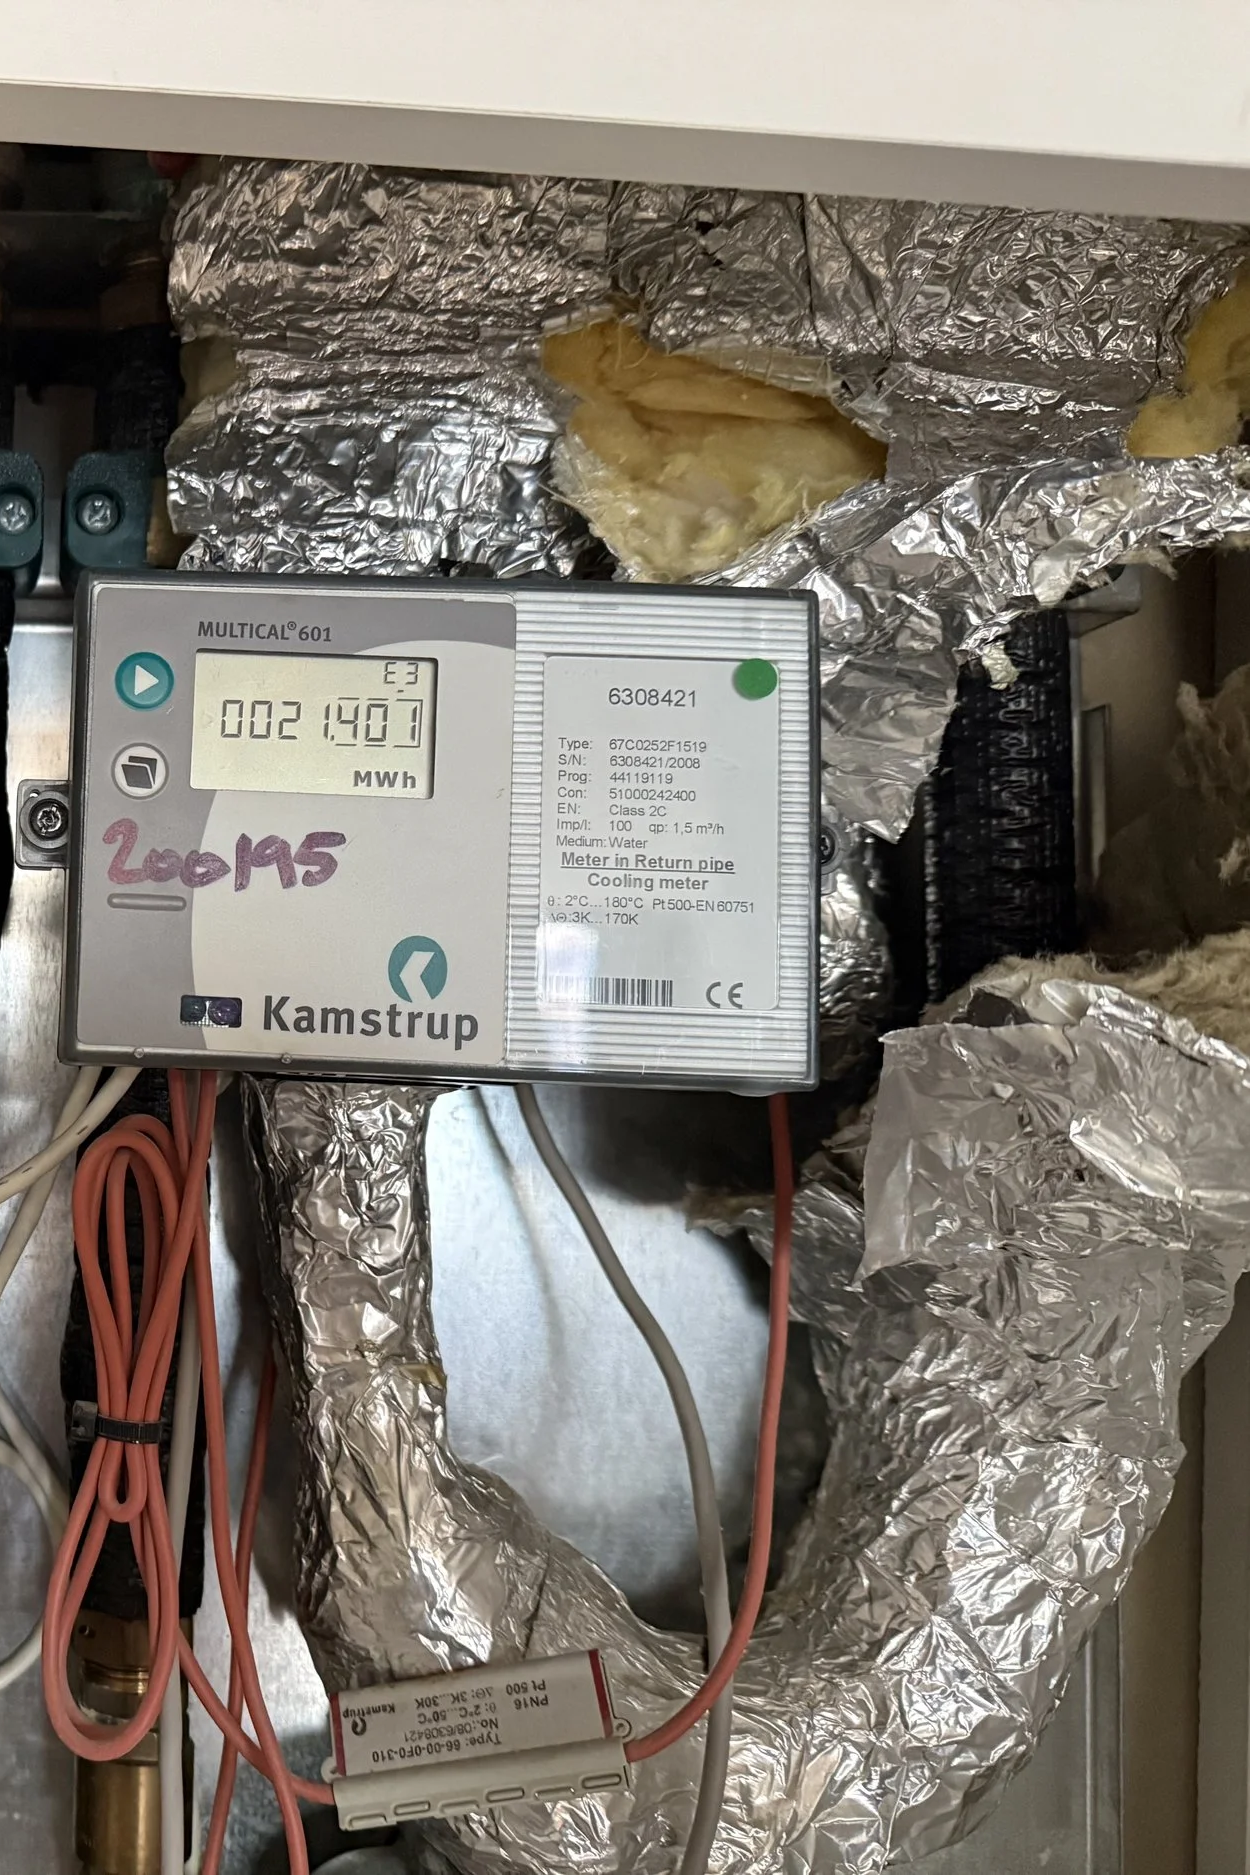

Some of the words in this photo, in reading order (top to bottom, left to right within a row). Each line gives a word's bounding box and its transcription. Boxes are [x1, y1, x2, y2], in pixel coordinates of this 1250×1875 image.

[298, 626, 332, 643] 601
[608, 688, 697, 708] 6308421
[558, 737, 593, 751] Type:
[609, 738, 707, 753] 67C0252F1519
[558, 754, 587, 767] S/N:
[609, 755, 701, 769] 6308421/2008
[353, 770, 417, 790] MWh
[558, 770, 592, 784] Prog:
[609, 772, 673, 785] 44119119
[557, 786, 587, 799] Con:
[609, 788, 696, 802] 51000242400
[557, 803, 581, 815] EN:
[609, 804, 645, 816] Class
[649, 805, 667, 817] 2C
[610, 820, 632, 832] 100
[649, 823, 668, 835] qp:
[673, 822, 693, 836] 1,5
[696, 823, 725, 835] m³/h
[556, 835, 607, 848] Medium:
[608, 836, 649, 849] Water
[561, 852, 610, 867] Meter
[615, 853, 630, 868] in
[635, 854, 693, 870] Return
[699, 856, 735, 873] pipe
[587, 873, 654, 891] Cooling
[659, 876, 709, 891] meter
[717, 901, 755, 914] 60751
[263, 995, 479, 1051] Kamstrup
[505, 1682, 529, 1695] 500
[531, 1679, 546, 1691] Pt
[514, 1695, 549, 1711] PN16
[466, 1733, 502, 1748] Type:
